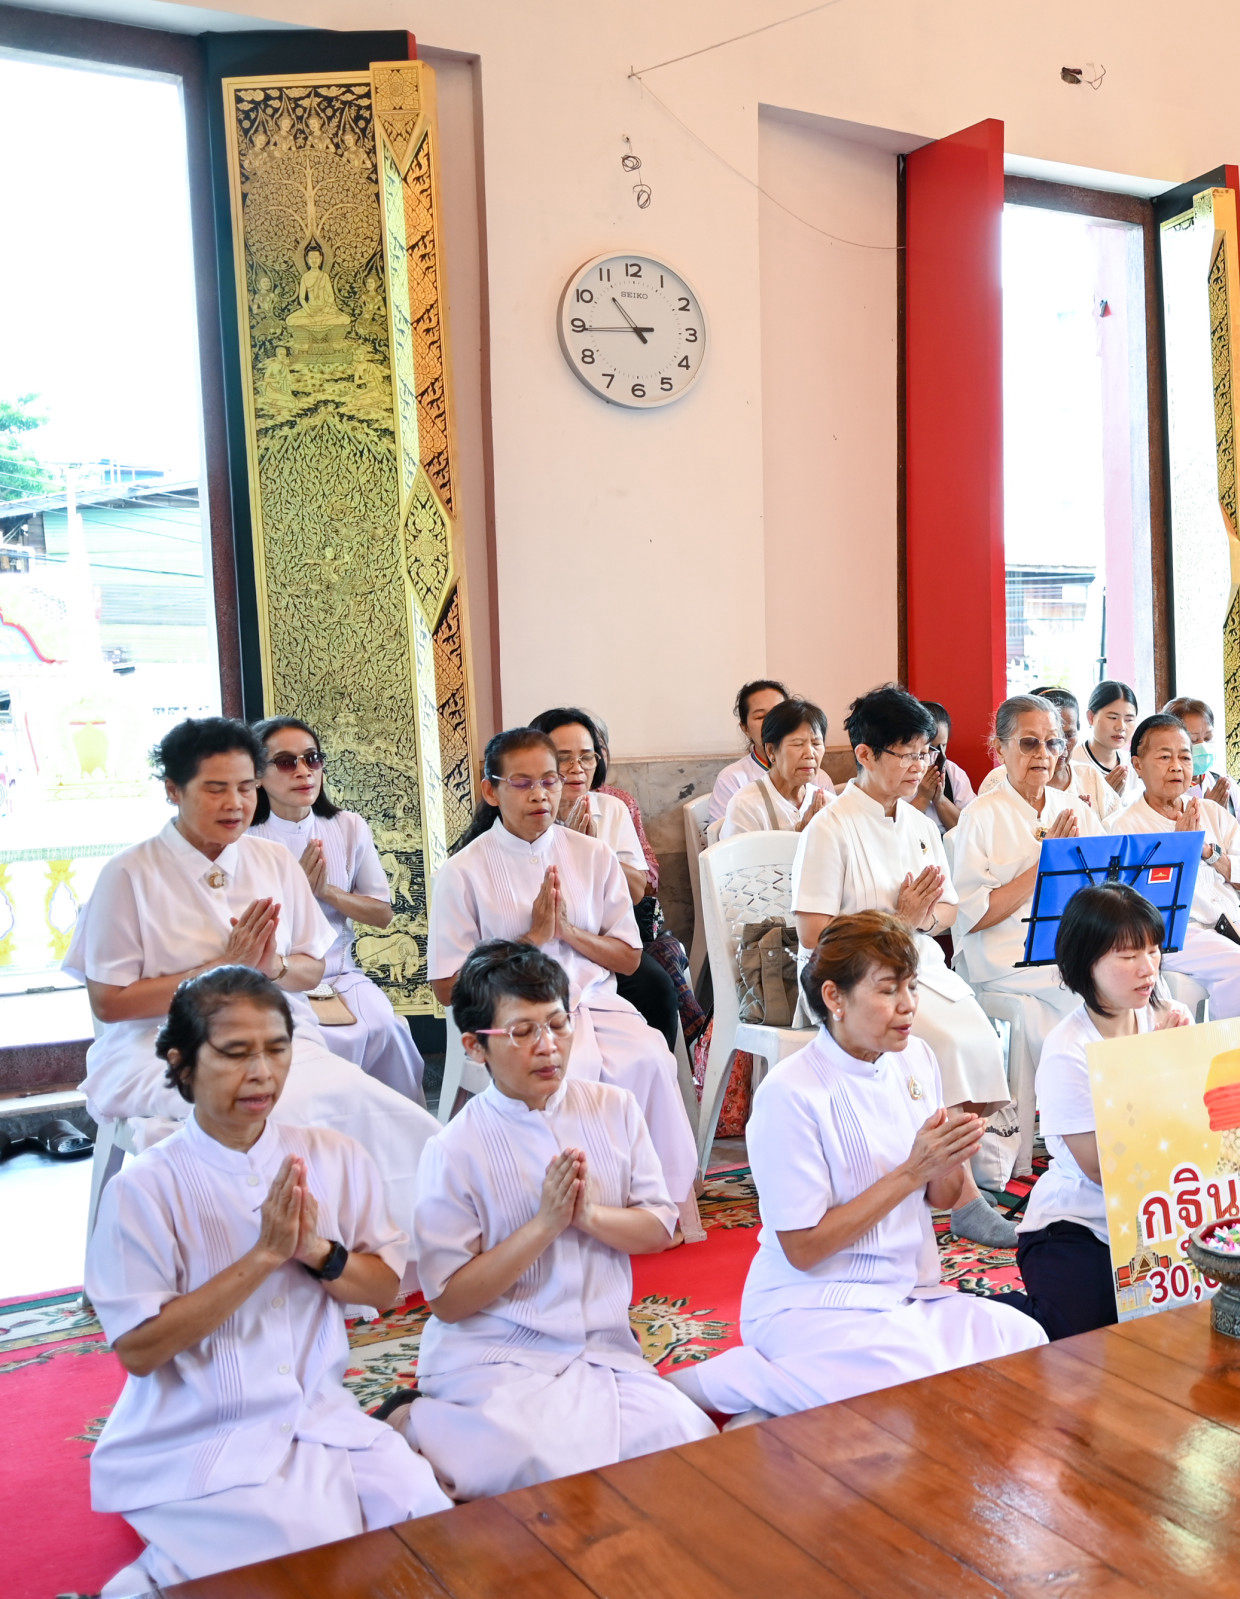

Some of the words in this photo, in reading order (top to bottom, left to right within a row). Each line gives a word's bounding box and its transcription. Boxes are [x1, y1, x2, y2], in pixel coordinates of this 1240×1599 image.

[599, 267, 611, 282] 11
[625, 263, 642, 278] 12
[660, 275, 664, 288] 1
[576, 289, 594, 304] 10
[620, 291, 649, 300] SEIKO
[678, 297, 691, 312] 2
[570, 318, 586, 333] 9
[685, 328, 699, 343] 3
[581, 349, 595, 365] 8
[677, 355, 691, 371] 4
[602, 374, 615, 389] 7
[660, 377, 673, 392] 5
[631, 383, 646, 398] 6
